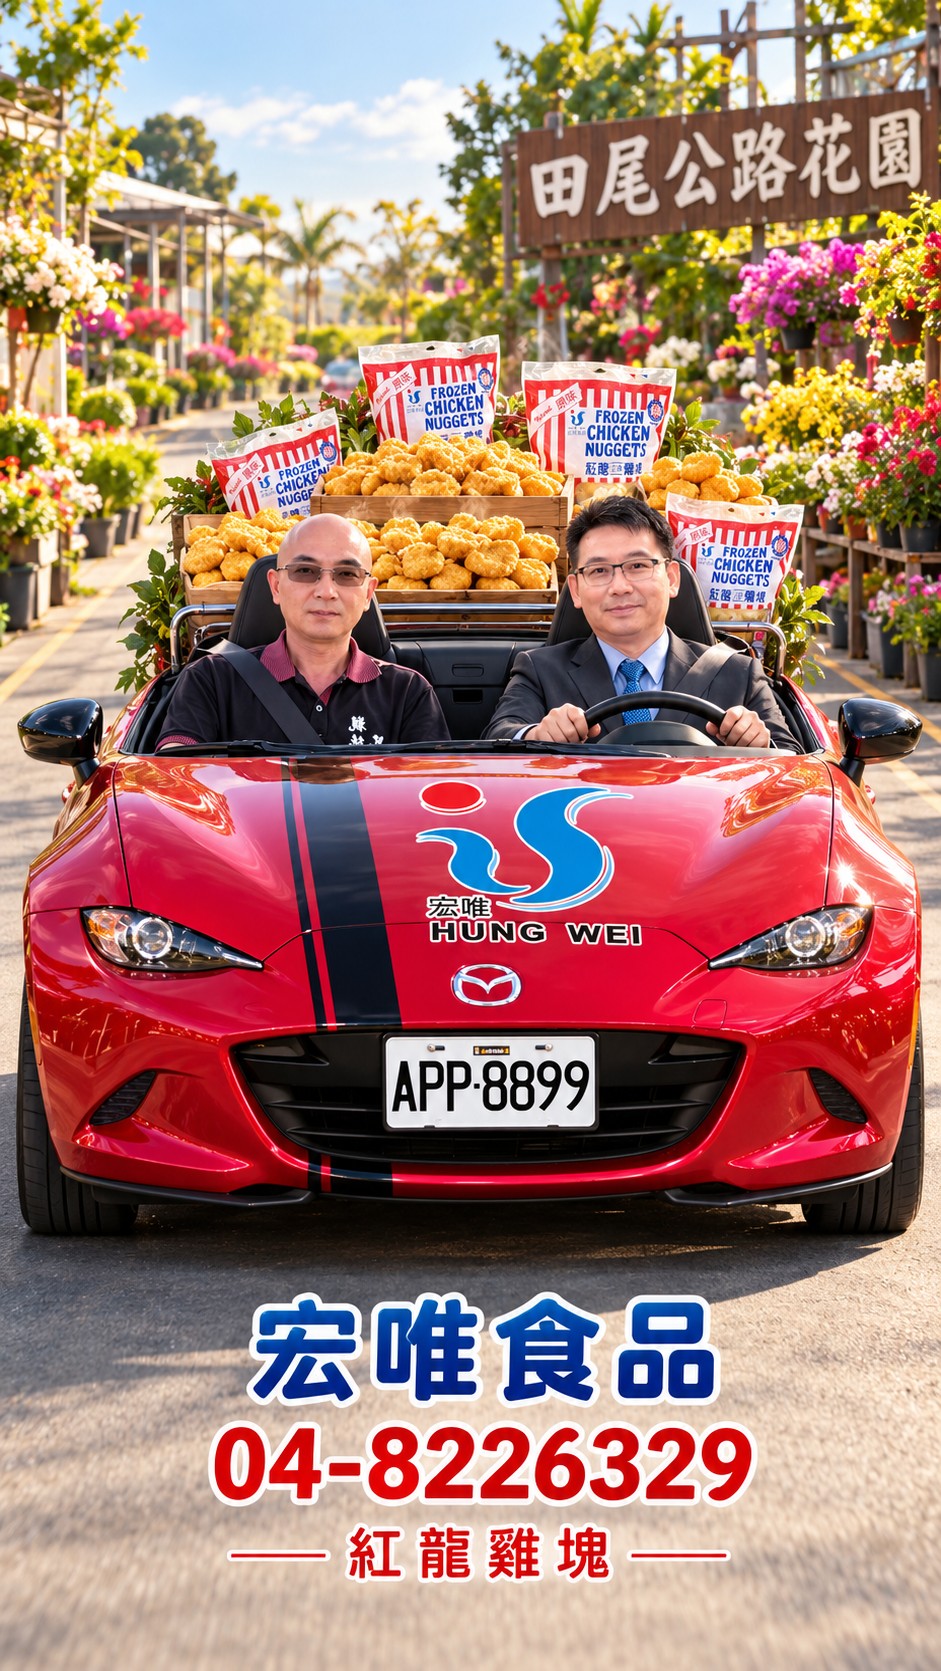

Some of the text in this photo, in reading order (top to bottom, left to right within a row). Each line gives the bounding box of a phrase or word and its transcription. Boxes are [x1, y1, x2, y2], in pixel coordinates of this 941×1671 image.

[531, 108, 921, 218] 田尾公路花園
[431, 382, 476, 400] FROZEN
[425, 394, 484, 416] CHICKEN
[425, 412, 484, 431] NUGGETS
[595, 410, 644, 424] FROZEN
[587, 425, 650, 441] CHICKEN
[585, 442, 647, 457] NUGGETS
[723, 546, 767, 558] FROZEN
[714, 558, 773, 573] CHICKEN
[711, 571, 770, 587] NUGGETS
[427, 895, 491, 918] 宏唯
[430, 922, 642, 945] HUNG WEI
